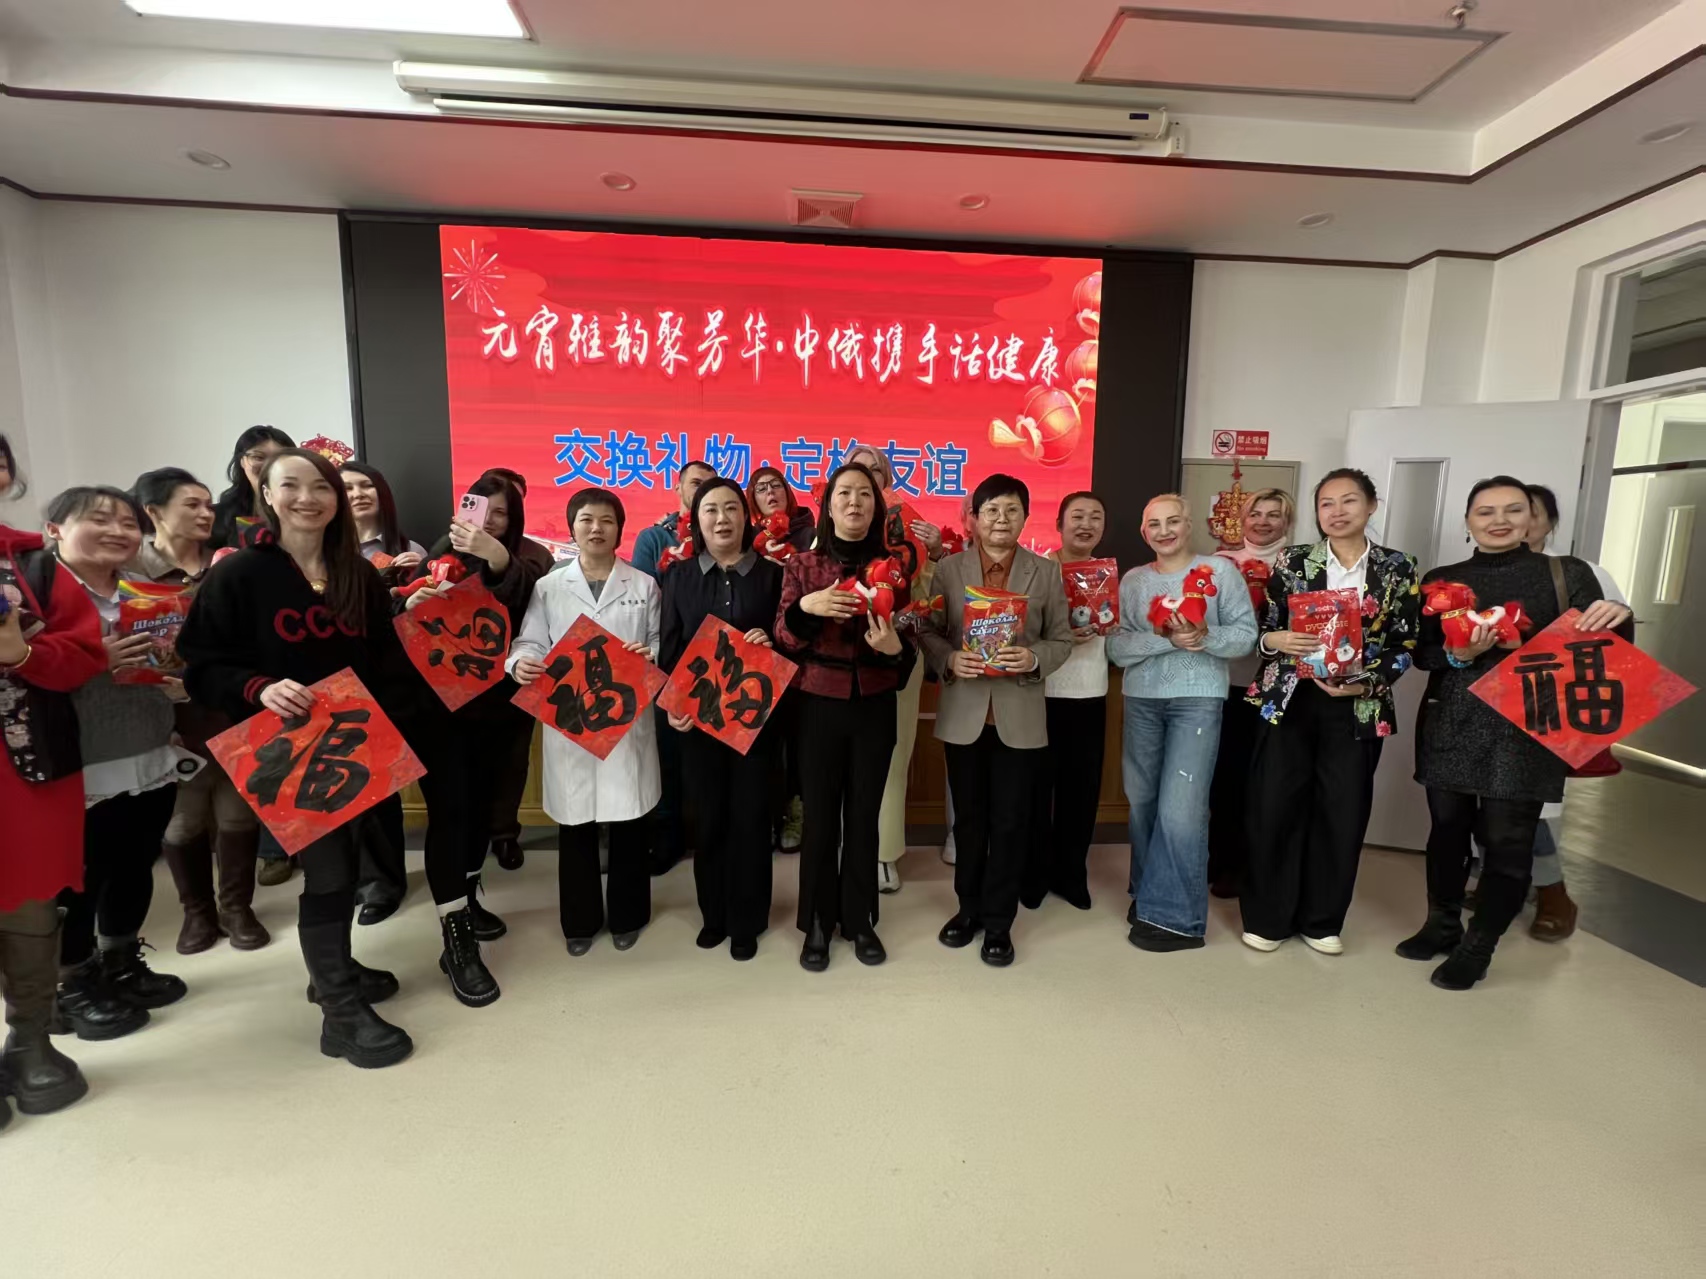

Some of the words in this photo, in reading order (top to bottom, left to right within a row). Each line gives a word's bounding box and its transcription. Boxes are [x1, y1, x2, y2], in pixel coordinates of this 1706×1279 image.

[971, 616, 1018, 627] Шоколад
[546, 635, 637, 735] 福
[1513, 638, 1624, 735] 福
[246, 708, 371, 814] 福
